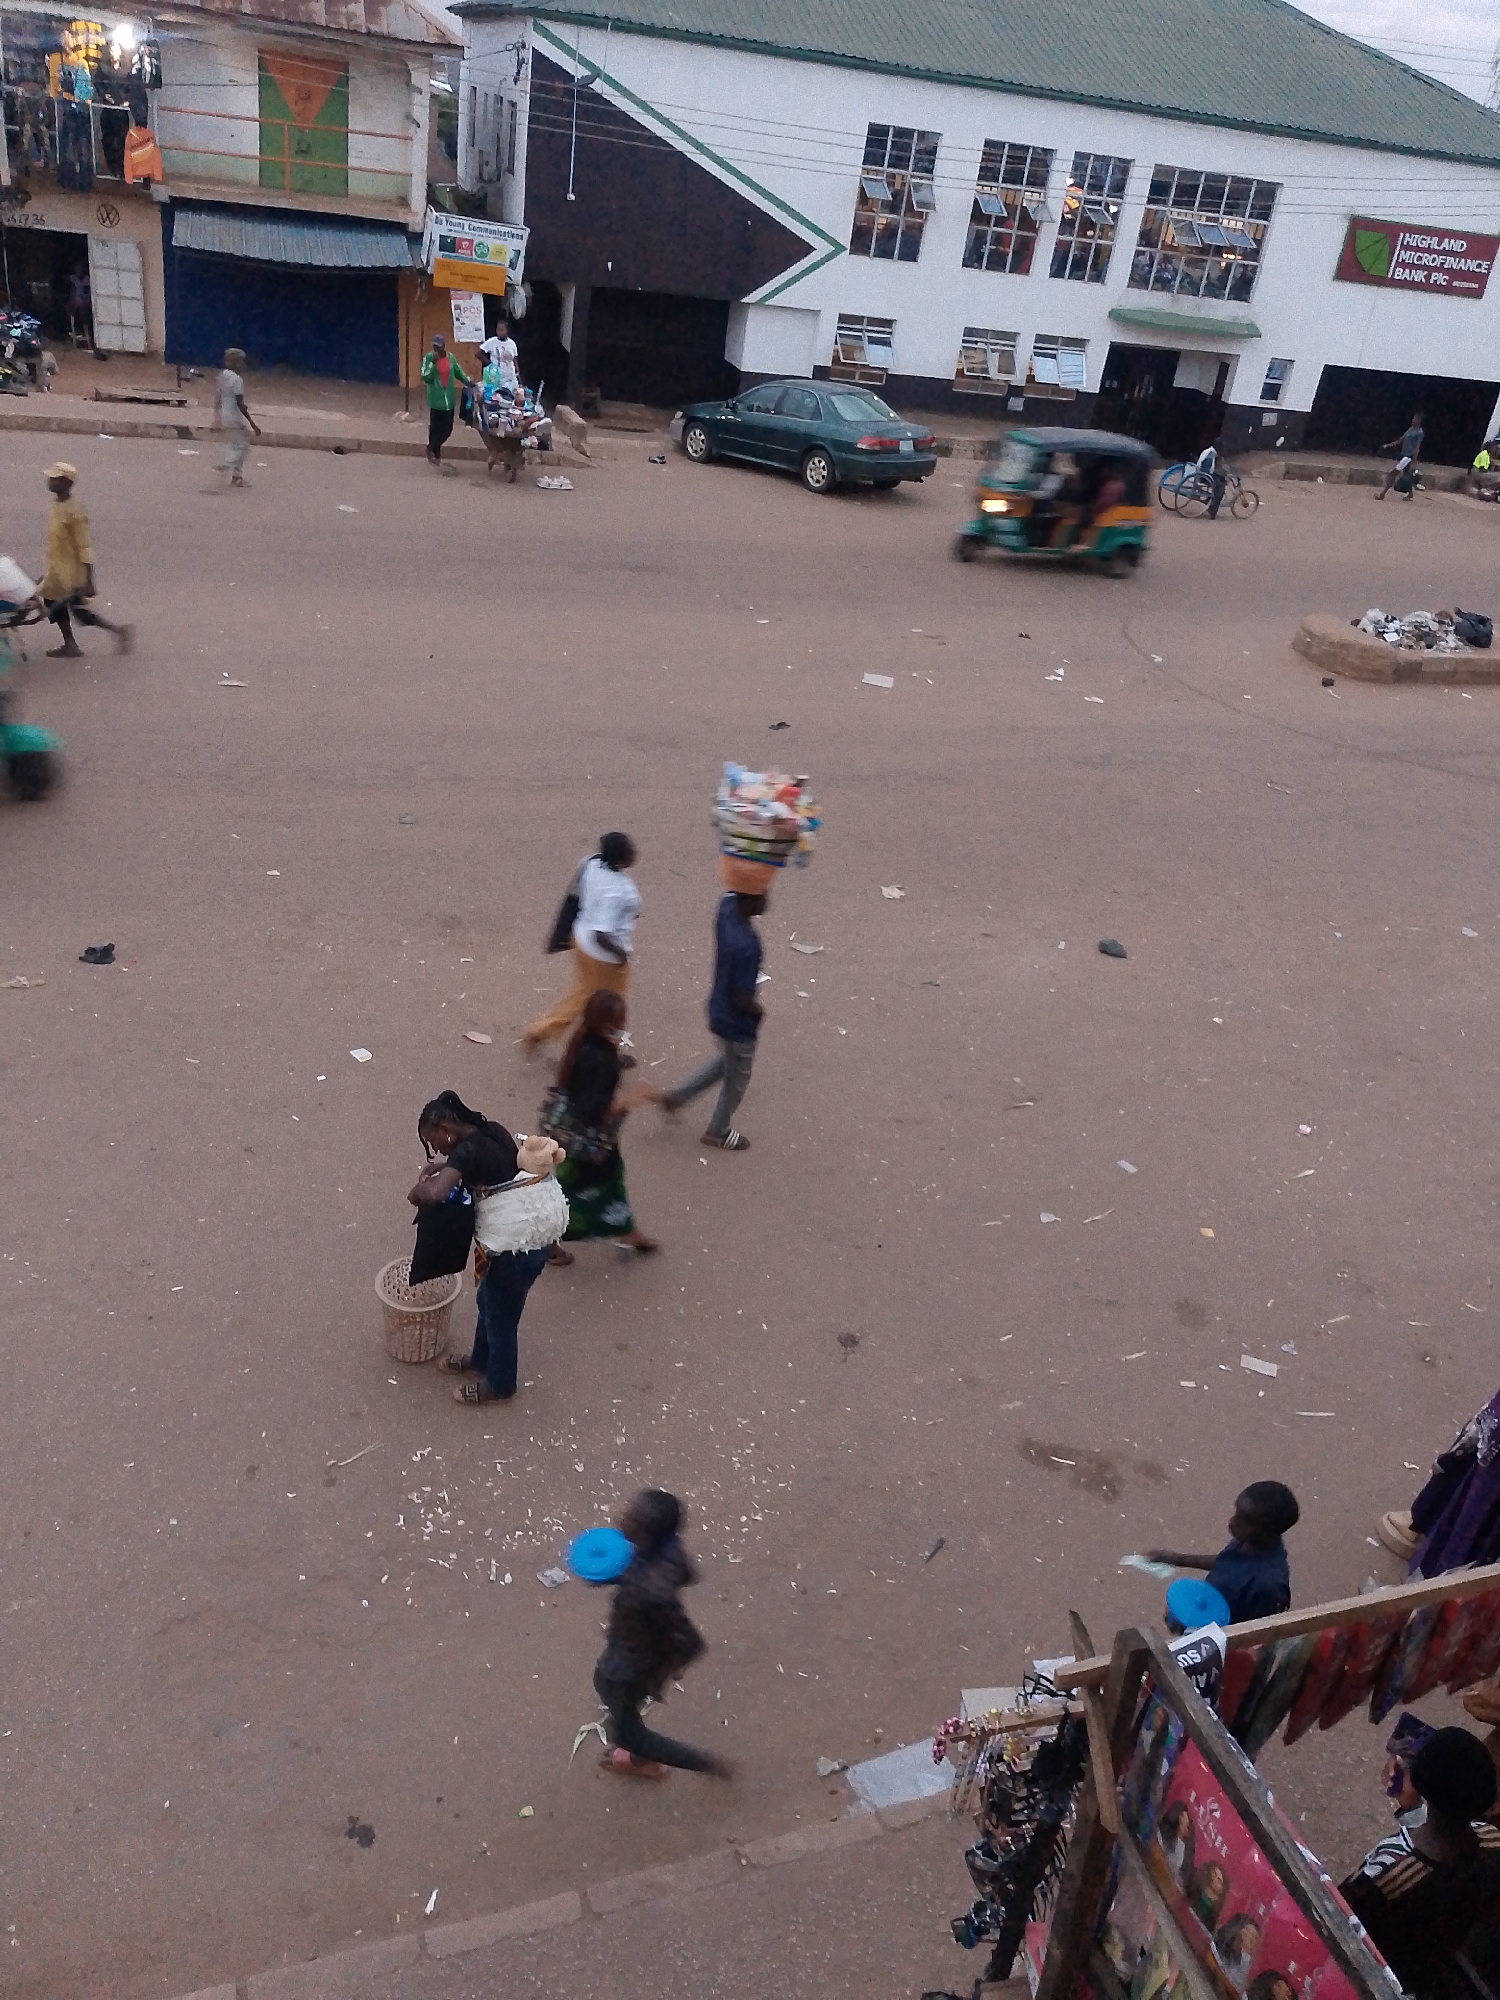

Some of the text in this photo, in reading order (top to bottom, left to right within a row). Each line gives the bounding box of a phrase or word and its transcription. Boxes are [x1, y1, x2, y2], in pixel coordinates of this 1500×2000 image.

[445, 216, 465, 230] Young
[467, 224, 524, 241] Communications
[1404, 233, 1467, 253] HIGHLAND
[1398, 250, 1490, 273] MICROFINANCE
[1394, 267, 1426, 284] BANK
[1430, 272, 1450, 286] Plc
